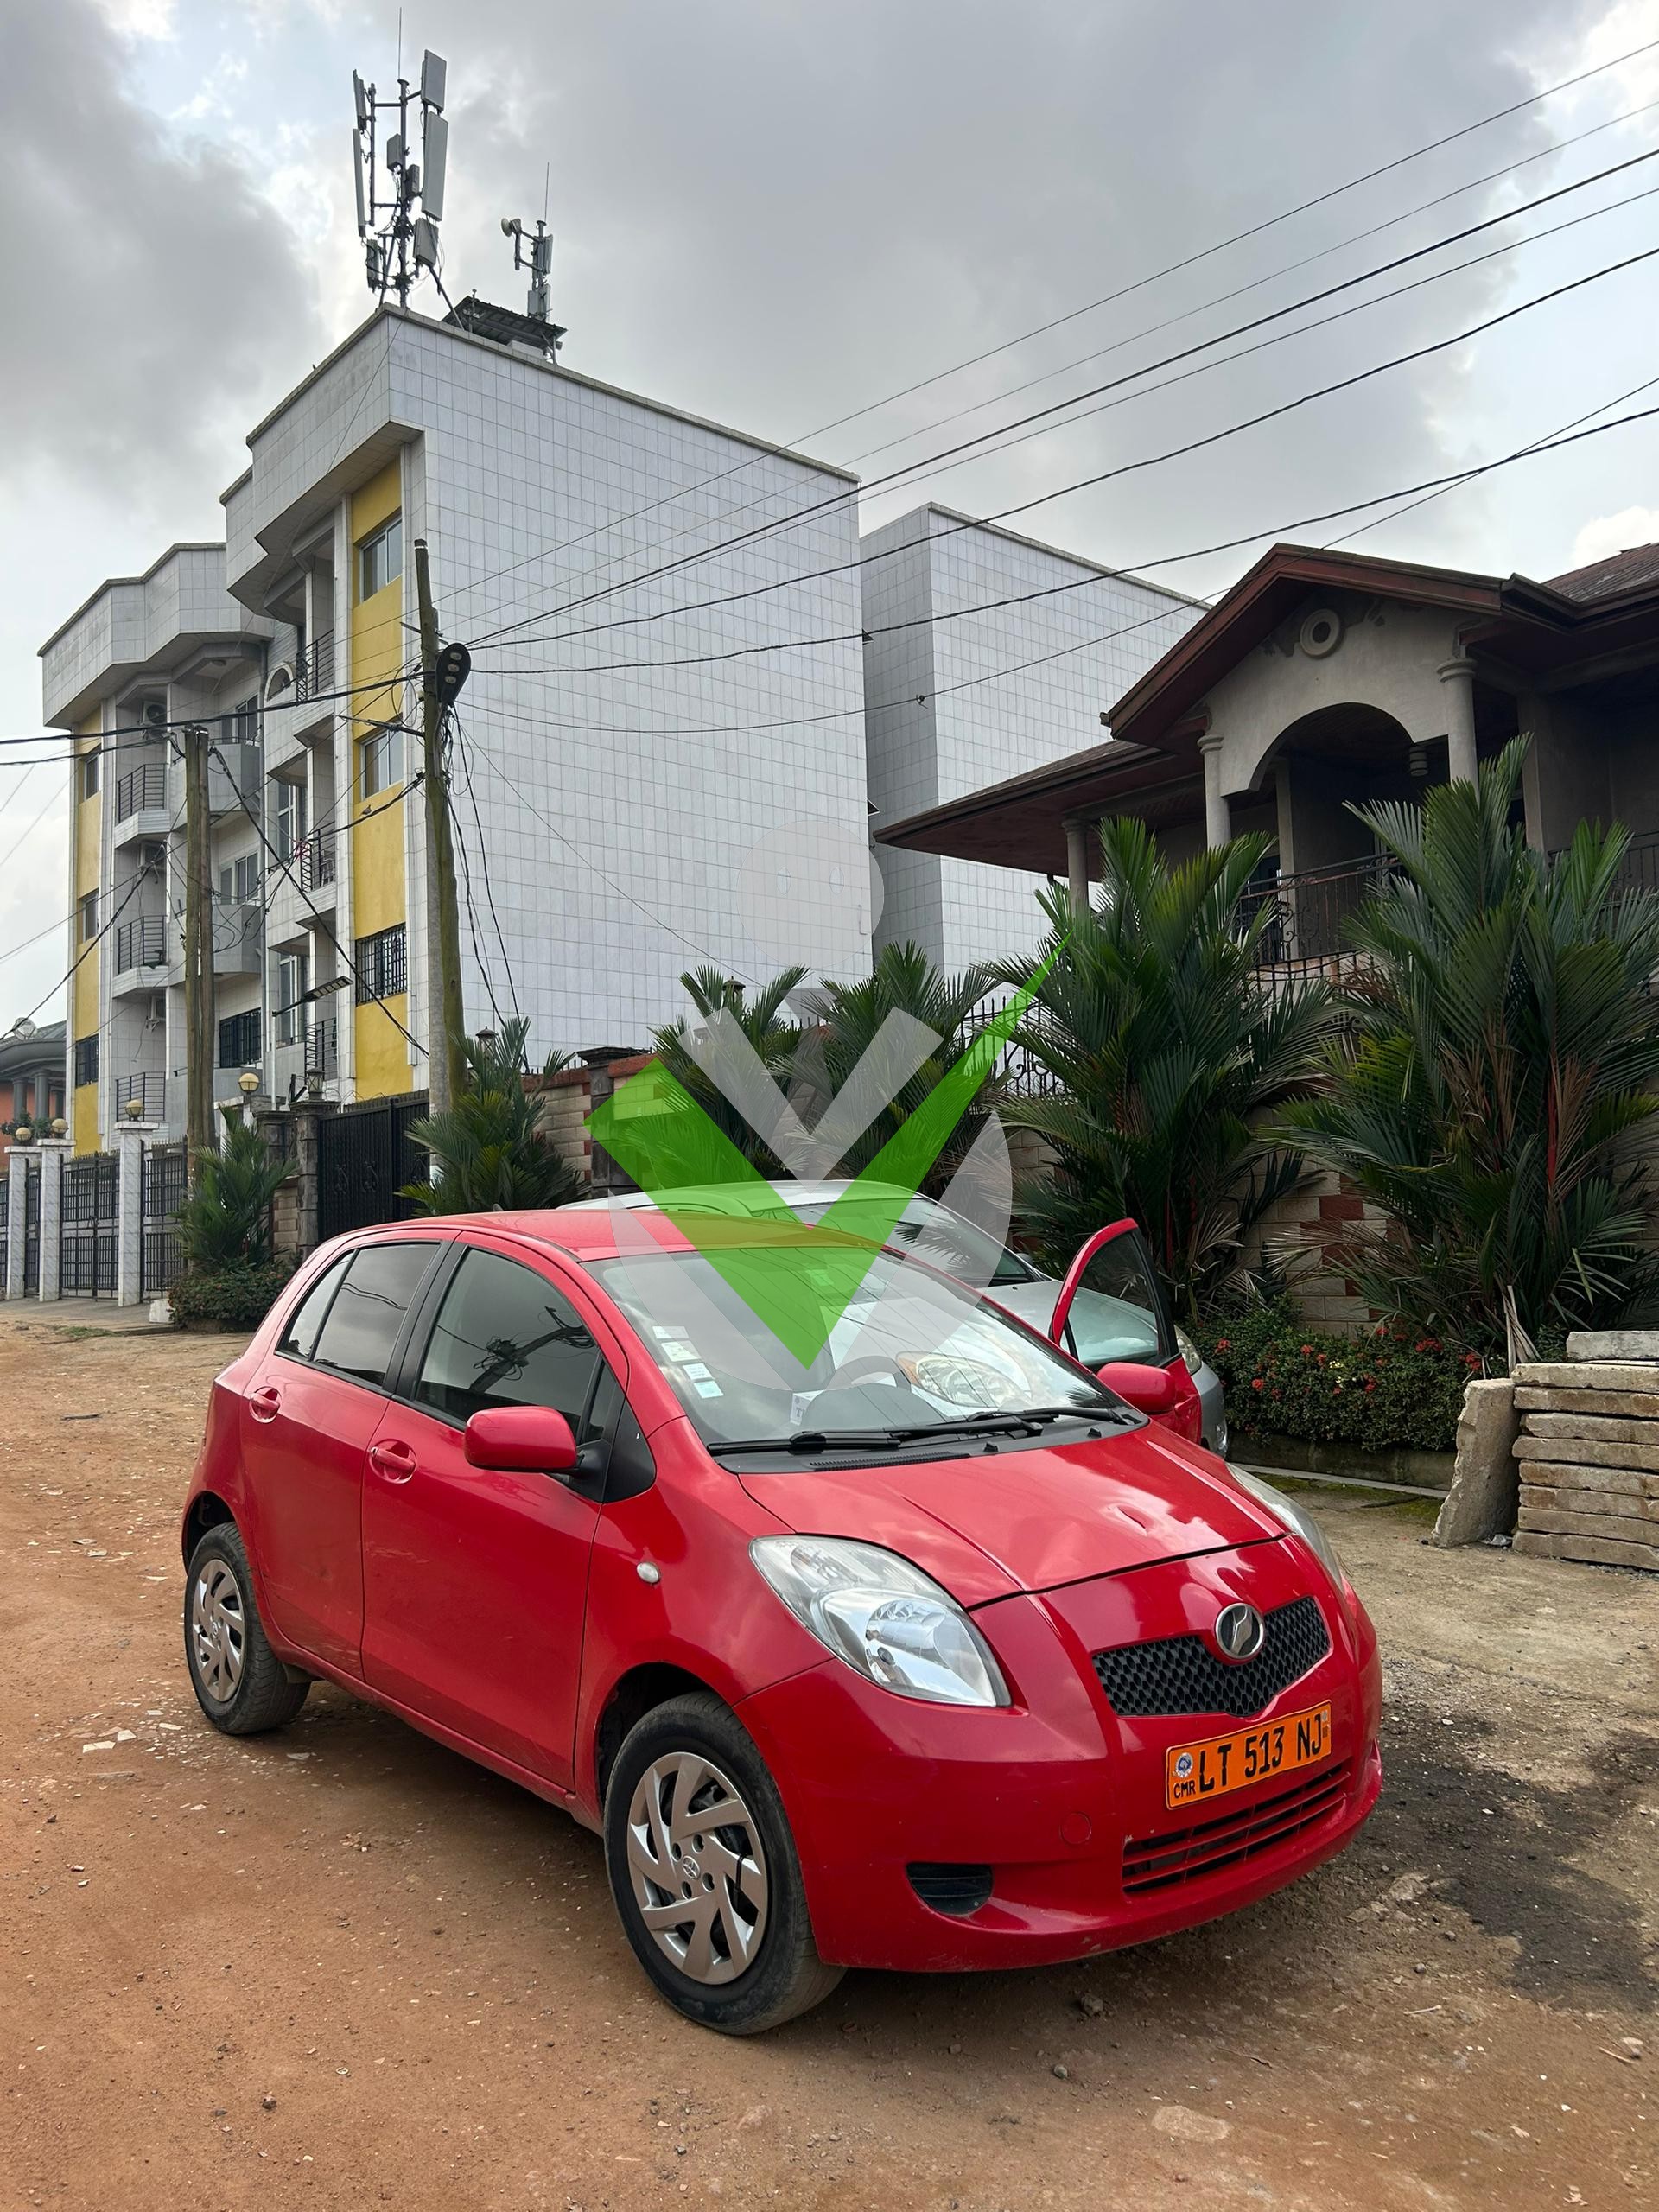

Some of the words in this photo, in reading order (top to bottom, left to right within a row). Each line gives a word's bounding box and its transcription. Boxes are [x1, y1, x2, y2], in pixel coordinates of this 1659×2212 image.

[1199, 1744, 1232, 1793] LT
[1244, 1726, 1285, 1778] 513
[1297, 1713, 1322, 1761] NJ
[1173, 1780, 1196, 1798] CMR
